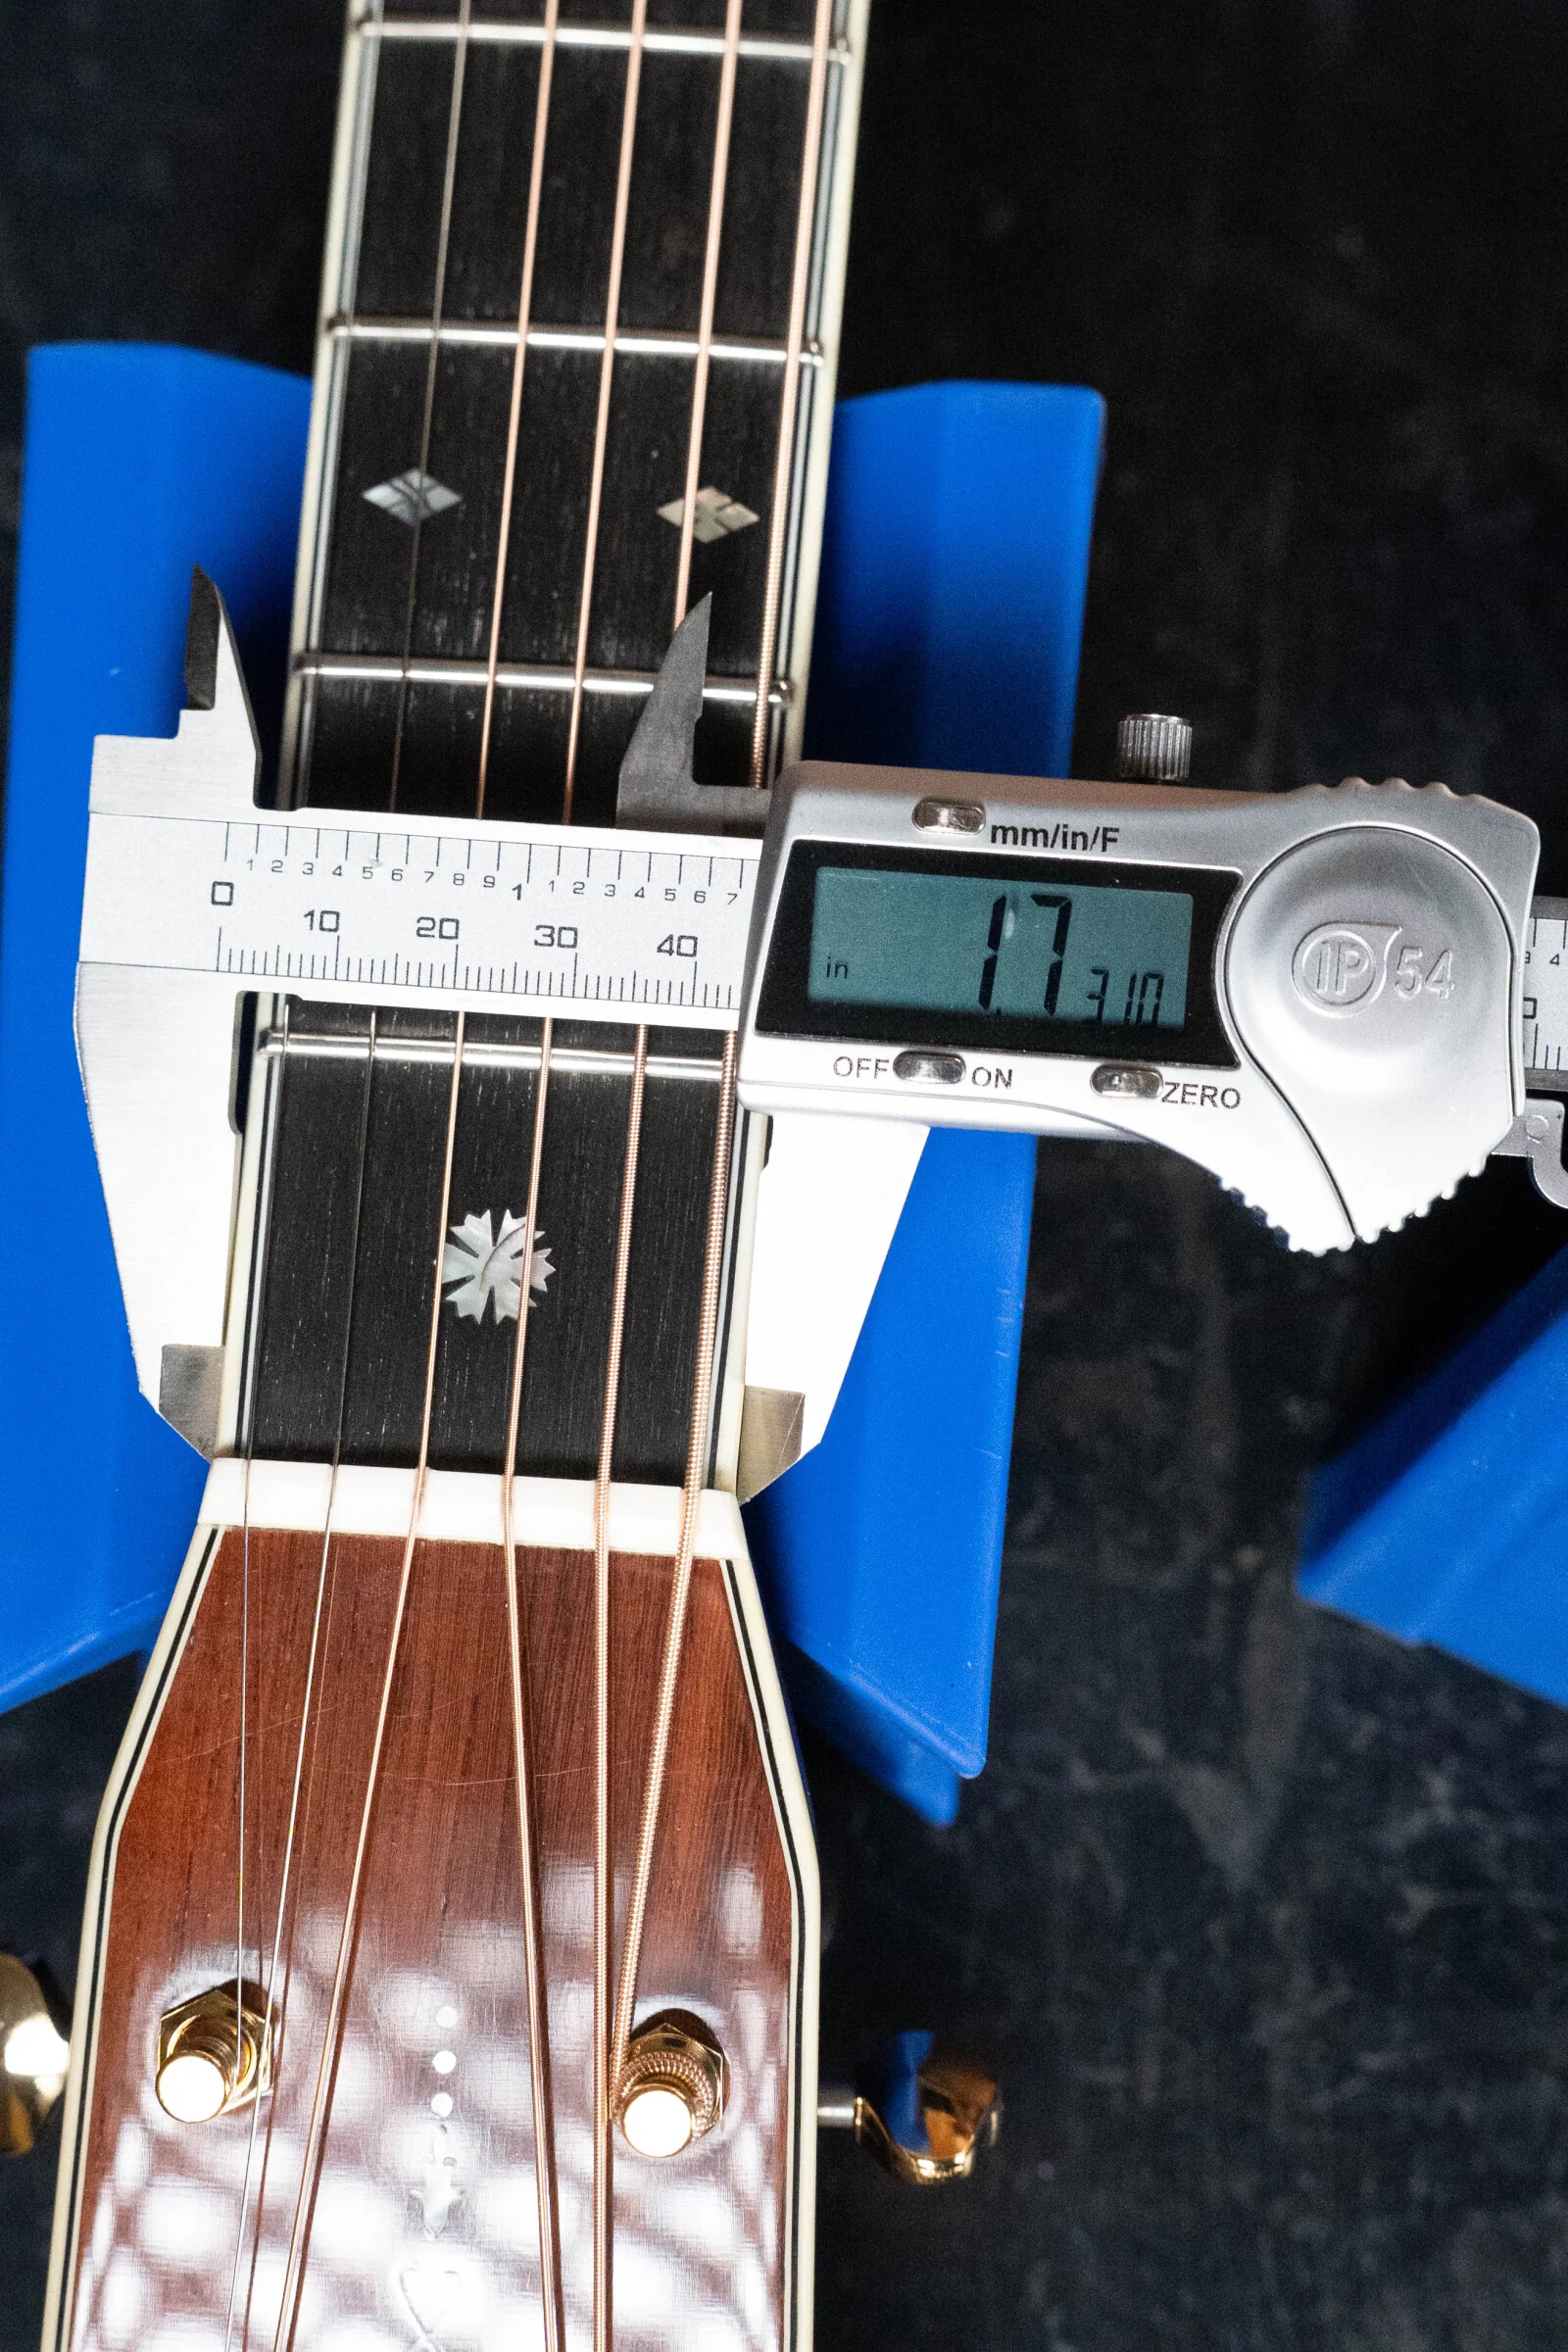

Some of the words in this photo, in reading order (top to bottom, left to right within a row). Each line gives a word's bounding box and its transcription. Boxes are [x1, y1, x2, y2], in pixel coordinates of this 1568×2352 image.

[990, 823, 1120, 854] mm/in/F
[247, 859, 253, 871] 1
[271, 859, 284, 873] 2
[302, 862, 315, 875] 3
[331, 865, 343, 877] 4
[362, 866, 374, 880] 5
[391, 868, 404, 882] 6
[423, 871, 435, 883] 7
[453, 873, 466, 886] 8
[483, 875, 496, 889] 9
[512, 883, 522, 901] 1
[548, 881, 555, 893] 1
[572, 882, 586, 895] 2
[604, 885, 616, 898] 3
[634, 887, 646, 900] 4
[664, 889, 676, 902] 5
[694, 891, 707, 904] 6
[726, 893, 738, 906] 7
[303, 909, 340, 932] 10
[416, 916, 460, 940] 20
[534, 925, 578, 949] 30
[657, 934, 698, 956] 40
[825, 956, 849, 979] in
[1394, 946, 1454, 1000] 54
[1549, 954, 1560, 966] 4
[833, 1055, 890, 1079] OFF
[971, 1066, 1013, 1090] ON
[1160, 1082, 1242, 1109] ZERO
